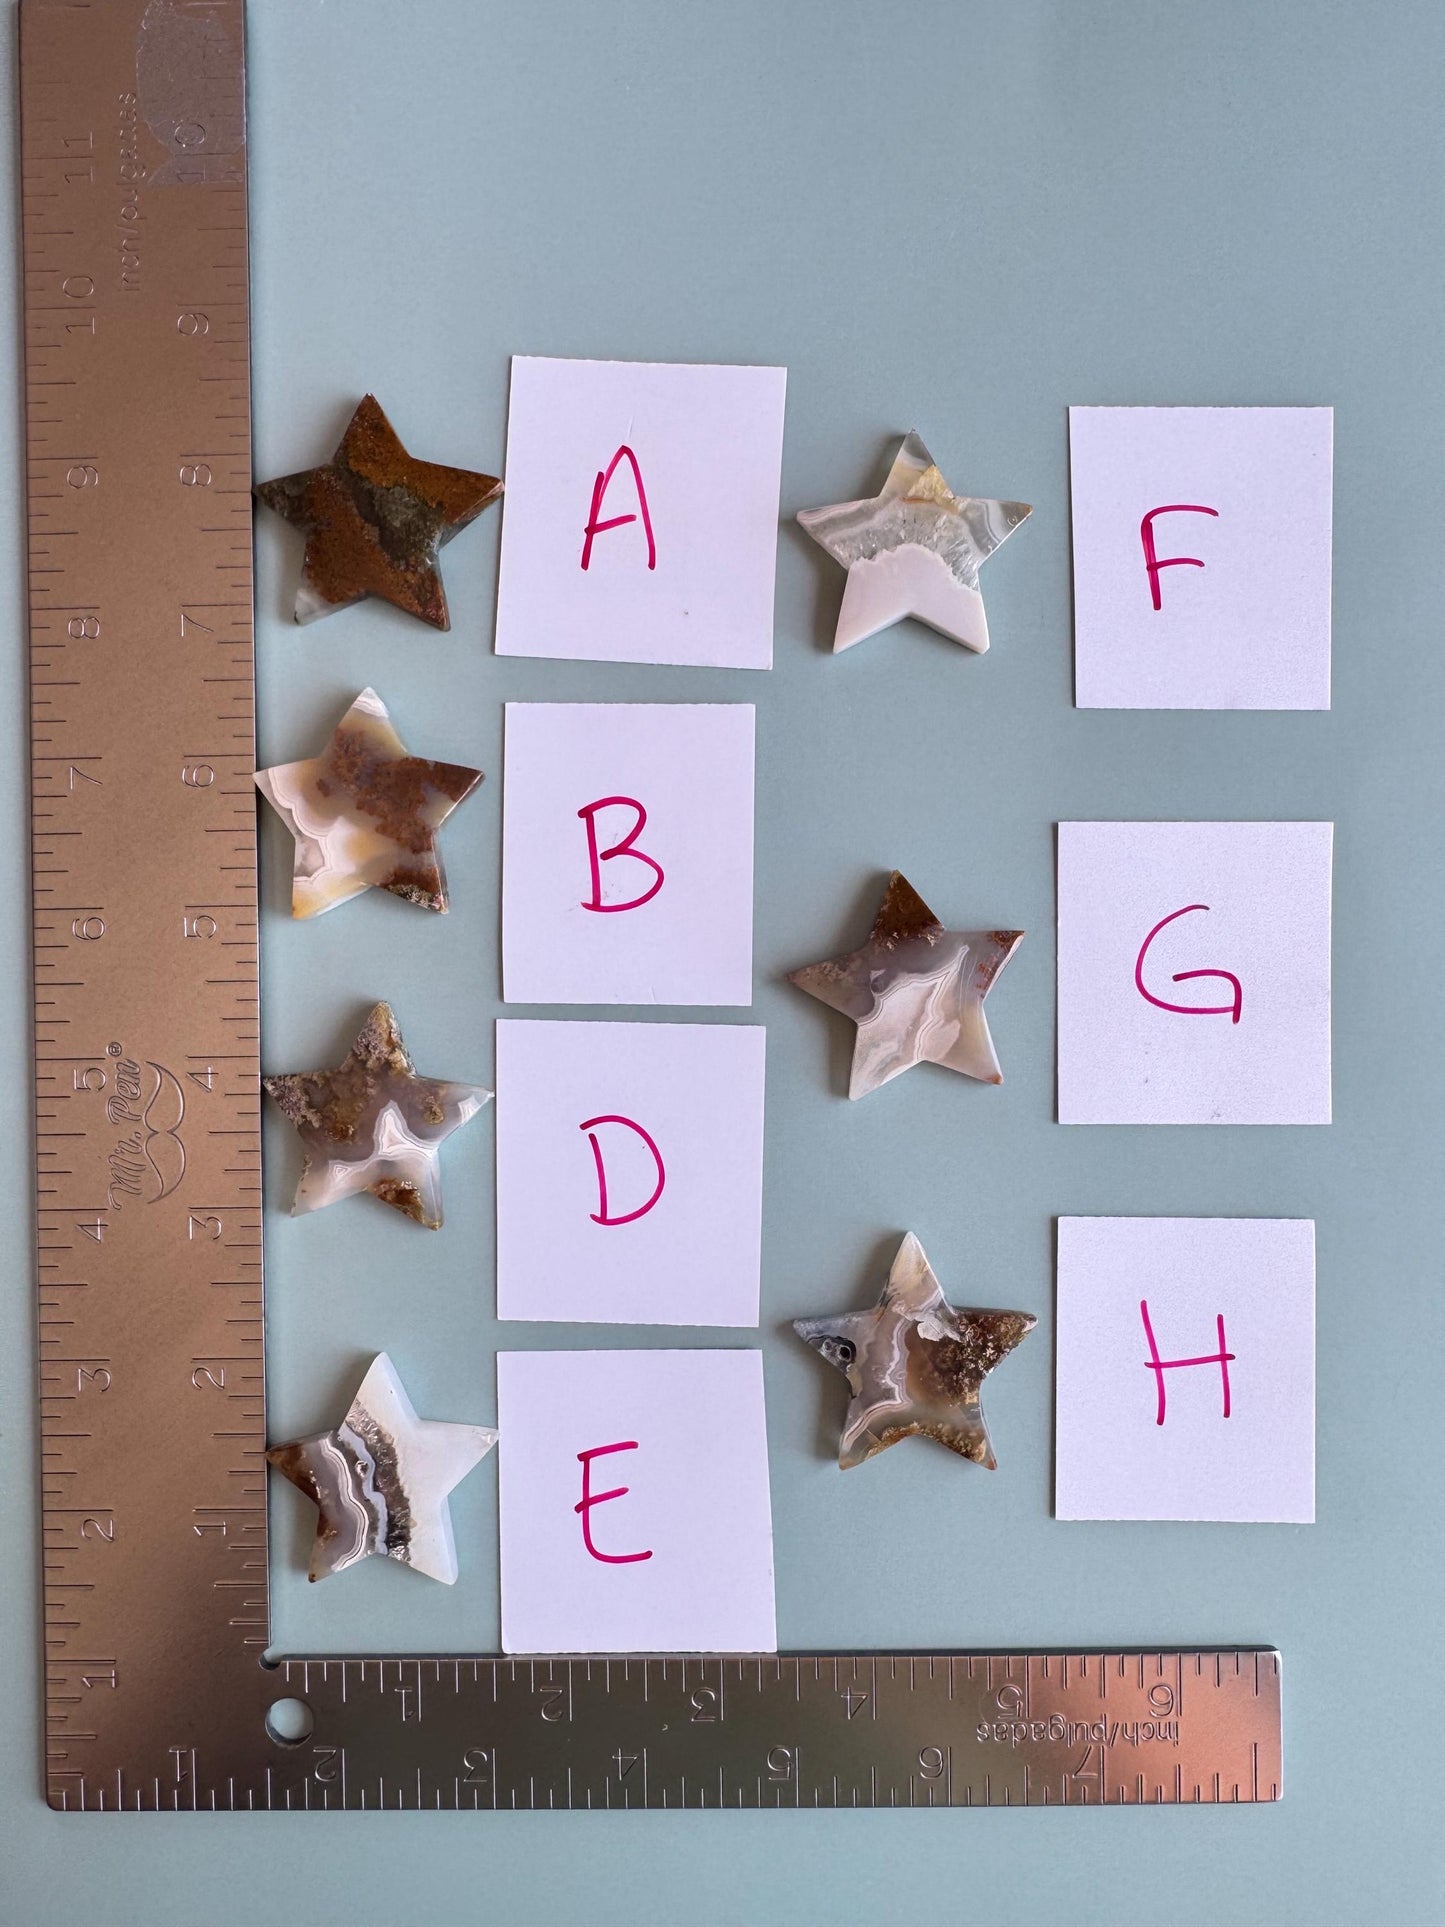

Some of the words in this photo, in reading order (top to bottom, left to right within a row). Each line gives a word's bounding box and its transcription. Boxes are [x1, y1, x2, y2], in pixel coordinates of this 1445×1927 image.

[62, 131, 94, 184] 11
[62, 275, 95, 335] 10
[177, 312, 209, 336] 9
[66, 464, 99, 489] 9
[179, 463, 212, 487] 8
[580, 444, 657, 571] A
[1140, 504, 1218, 611] F
[68, 616, 100, 639] 8
[180, 613, 214, 637] 7
[70, 766, 103, 790] 7
[182, 764, 214, 788] 6
[577, 795, 665, 914] B
[72, 916, 106, 941] 6
[183, 915, 217, 939] 5
[1135, 904, 1242, 1024] G
[73, 1067, 107, 1092] 5
[186, 1066, 219, 1092] 4
[107, 1131, 147, 1211] Mr.
[579, 1114, 666, 1227] D
[76, 1217, 109, 1244] 4
[189, 1215, 223, 1241] 3
[191, 1366, 226, 1390] 2
[1140, 1299, 1234, 1426] H
[78, 1367, 113, 1393] 3
[574, 1440, 653, 1565] E
[81, 1518, 116, 1543] 2
[193, 1520, 227, 1537] 1
[82, 1669, 117, 1688] 1
[394, 1686, 416, 1721] 1
[540, 1687, 563, 1722] 2
[691, 1687, 716, 1722] 3
[840, 1686, 869, 1721] 4
[996, 1683, 1023, 1718] 5
[1149, 1682, 1174, 1718] 6
[976, 1713, 1180, 1748] inch/pulgadas
[168, 1746, 188, 1782] 1
[313, 1746, 337, 1782] 2
[463, 1749, 488, 1783] 3
[612, 1747, 639, 1782] 4
[767, 1745, 791, 1781] 5
[919, 1746, 944, 1780] 6
[1072, 1745, 1098, 1779] 7
